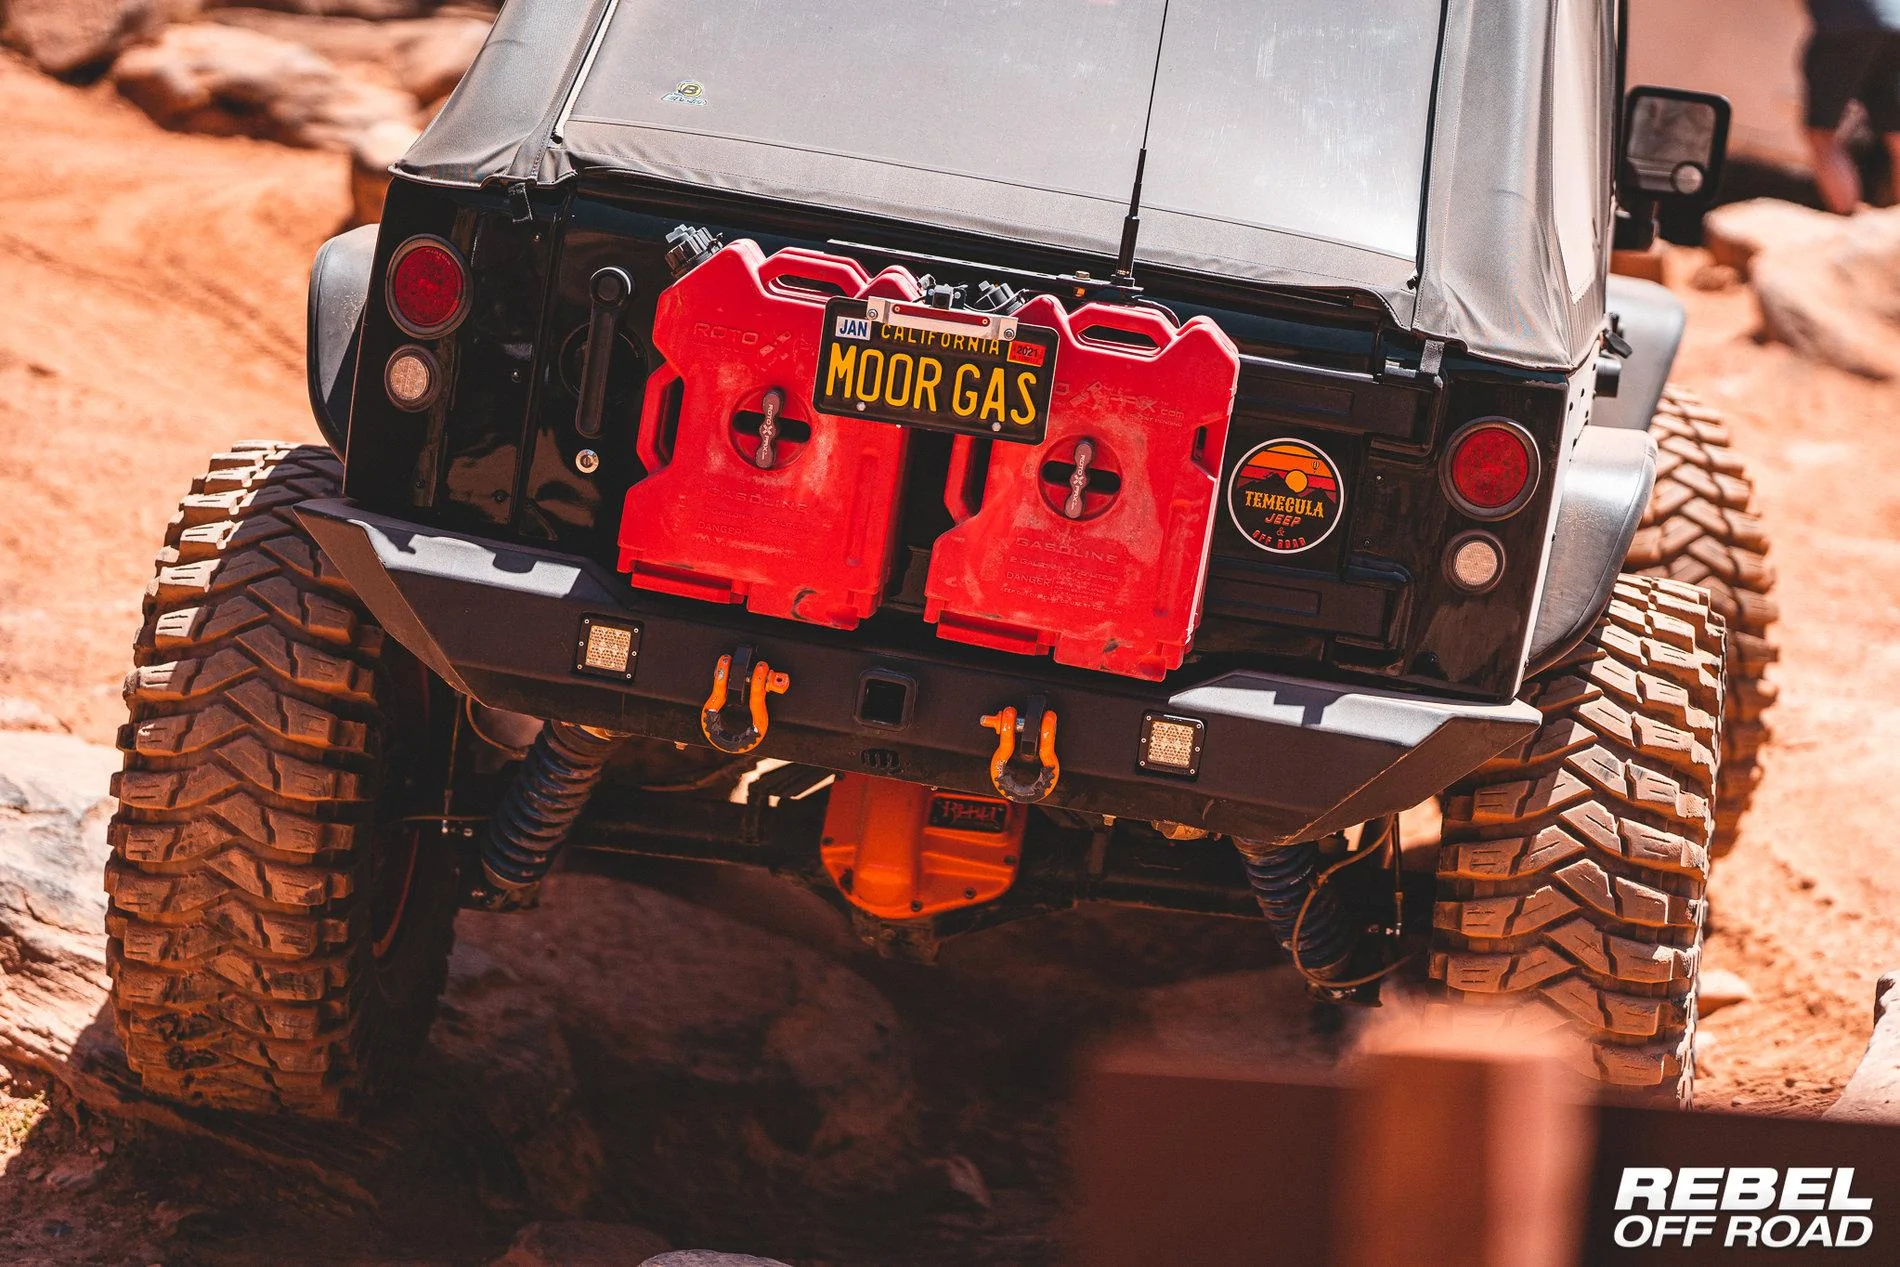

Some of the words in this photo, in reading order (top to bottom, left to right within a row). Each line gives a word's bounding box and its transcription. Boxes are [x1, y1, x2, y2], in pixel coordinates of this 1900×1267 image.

[693, 321, 759, 345] ROTO
[839, 319, 868, 338] JAN
[881, 323, 999, 355] CALIFORNIA
[1016, 346, 1039, 358] 2021
[825, 342, 942, 412] MOOR
[952, 363, 1037, 426] GAS
[697, 521, 742, 536] DANGER
[1265, 513, 1302, 528] JEEP
[1251, 529, 1272, 545] OFF
[1277, 537, 1307, 550] ROAD
[1276, 527, 1285, 537] &
[1015, 536, 1118, 564] GASOLINE
[1006, 571, 1051, 586] DANGER
